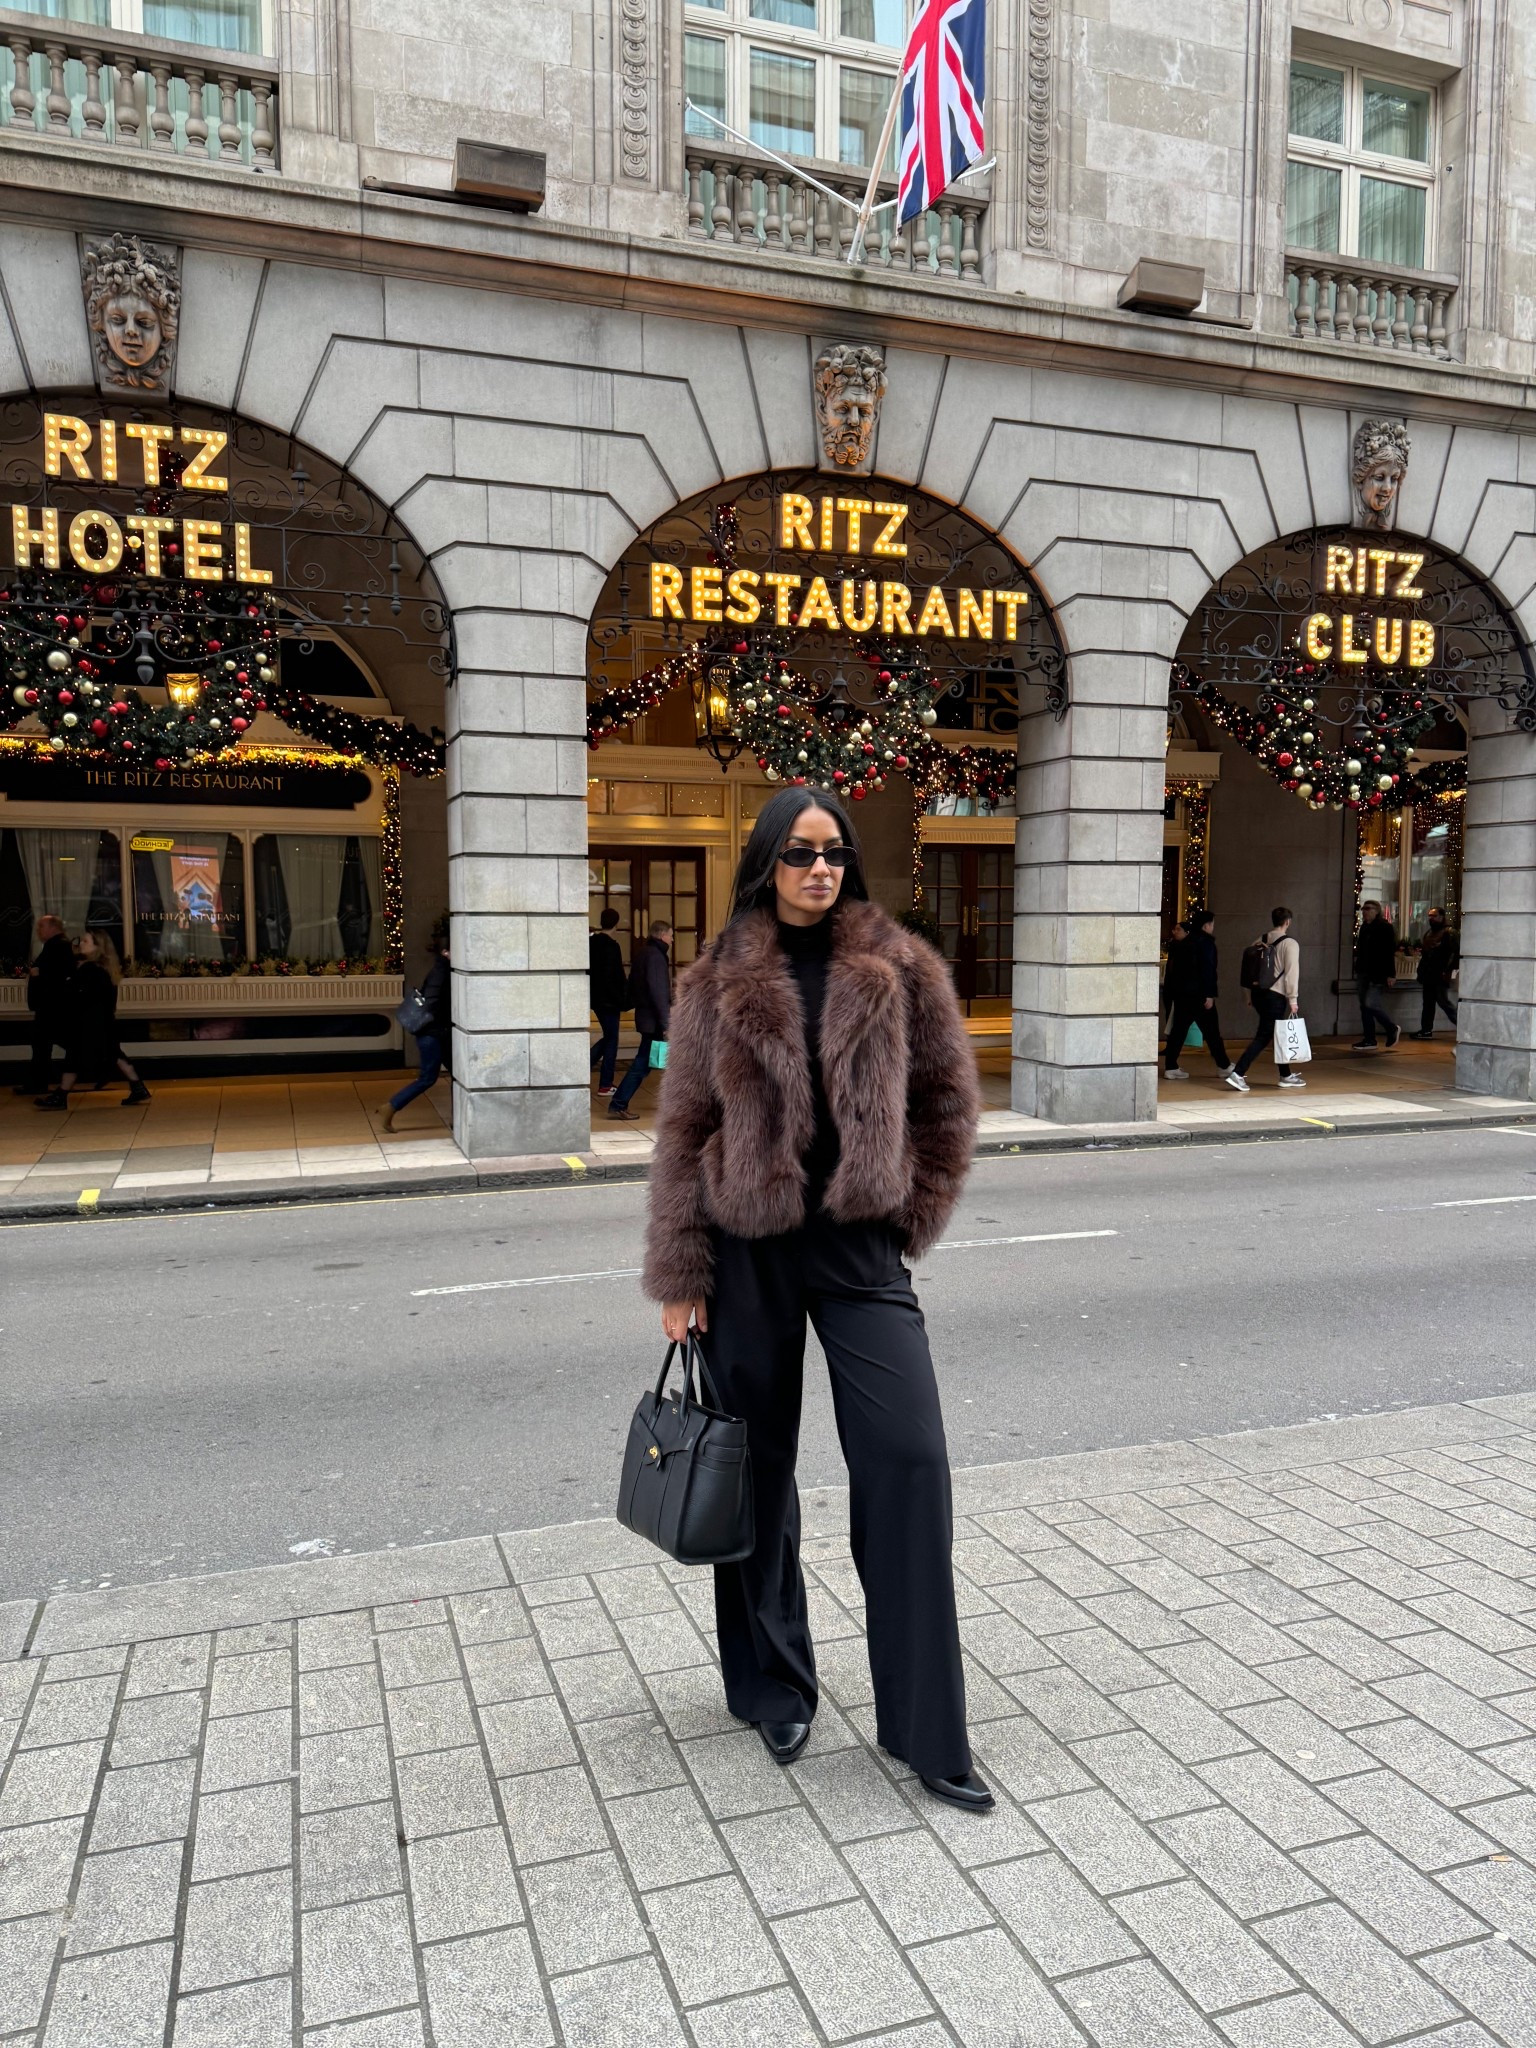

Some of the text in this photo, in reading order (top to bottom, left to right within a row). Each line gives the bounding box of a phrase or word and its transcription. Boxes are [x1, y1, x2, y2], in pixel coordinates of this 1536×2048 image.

[43, 413, 228, 491] RITZ
[11, 505, 273, 583] HOTEL
[781, 493, 909, 557] RITZ
[649, 562, 1028, 641] RESTAURANT
[1325, 545, 1424, 599] RITZ
[1305, 613, 1436, 667] CLUB
[86, 770, 284, 791] THE RITZ RESTAURANT
[141, 912, 155, 921] THE
[159, 912, 180, 921] RITZ
